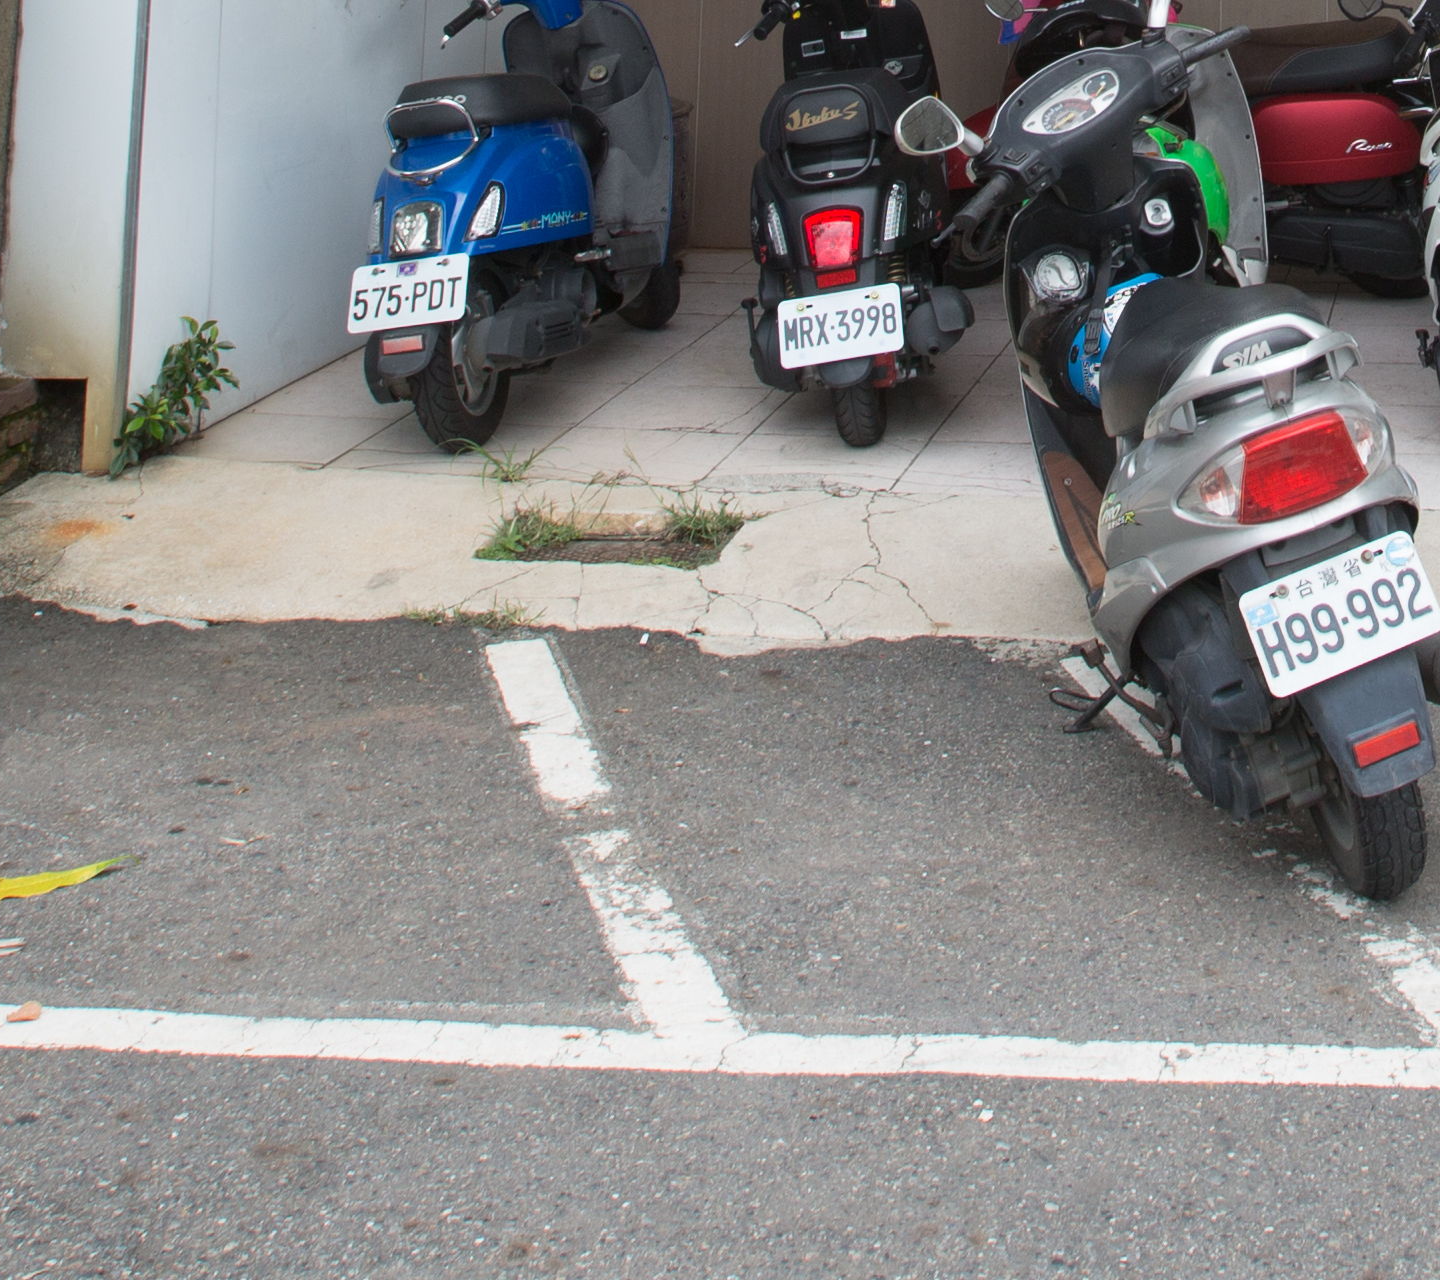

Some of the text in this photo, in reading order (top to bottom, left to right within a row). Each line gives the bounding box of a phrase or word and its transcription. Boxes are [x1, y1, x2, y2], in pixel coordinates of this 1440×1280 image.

[1222, 339, 1272, 371] SYM
[1294, 557, 1362, 598] 台灣省
